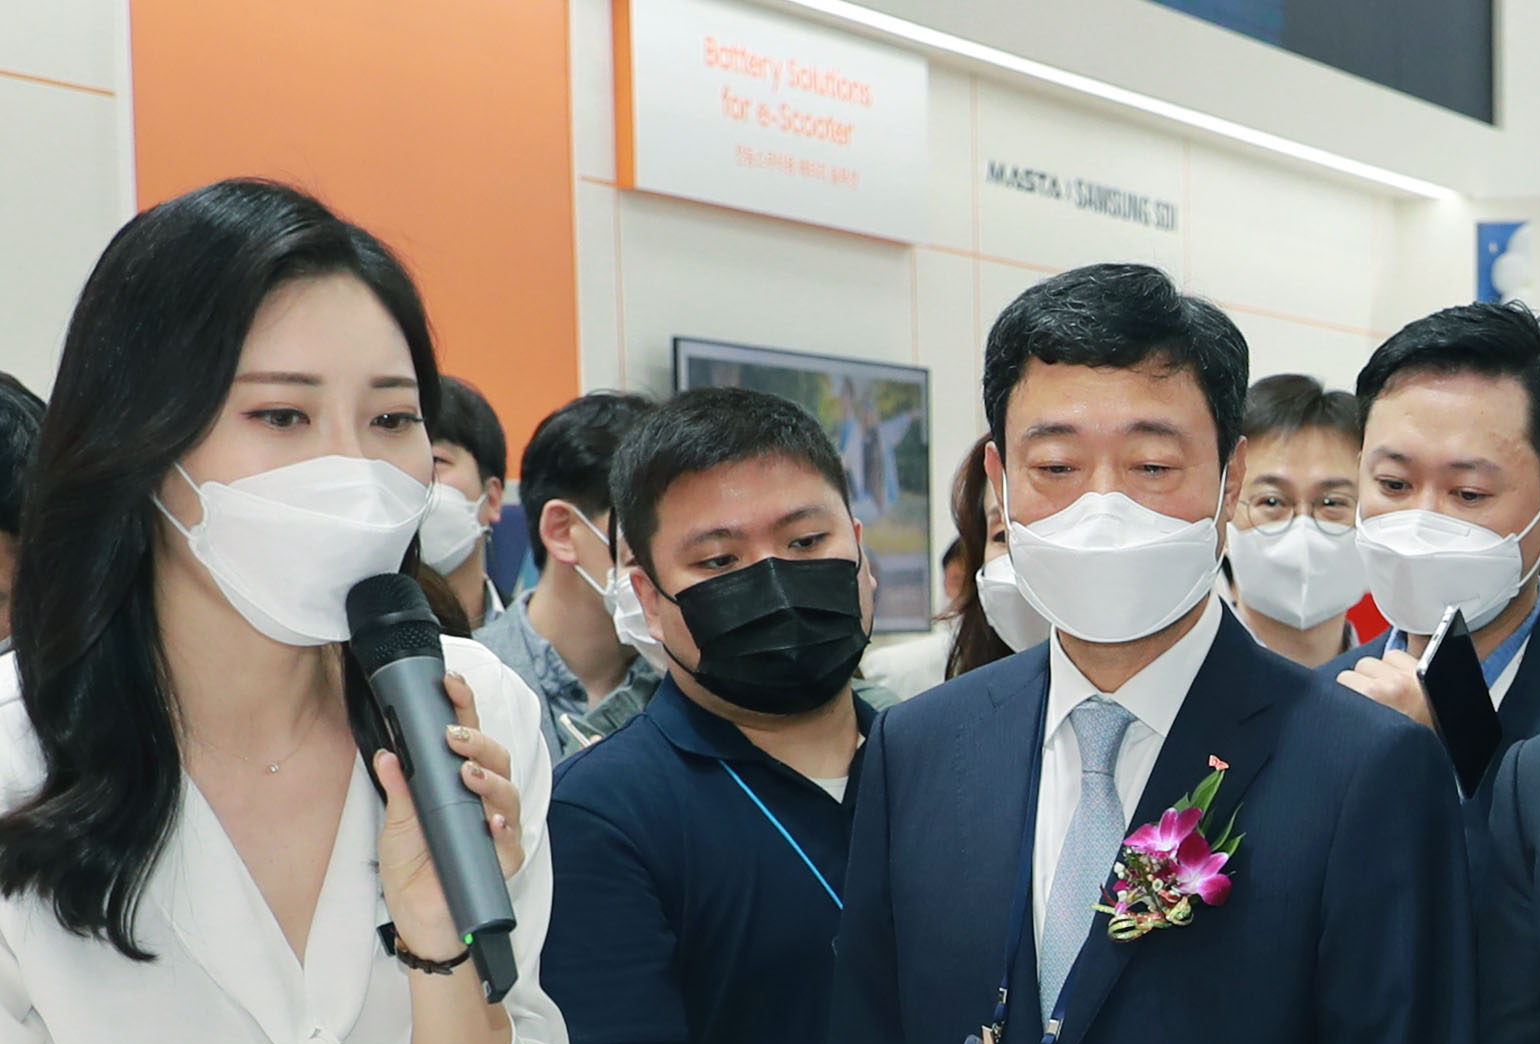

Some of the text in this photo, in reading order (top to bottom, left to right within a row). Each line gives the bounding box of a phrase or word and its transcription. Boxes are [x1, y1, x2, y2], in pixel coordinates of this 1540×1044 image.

[705, 35, 873, 107] Battery Solutions
[721, 84, 854, 146] for e-Scooter
[987, 159, 1179, 231] MASTA SAMSUNG SDI
